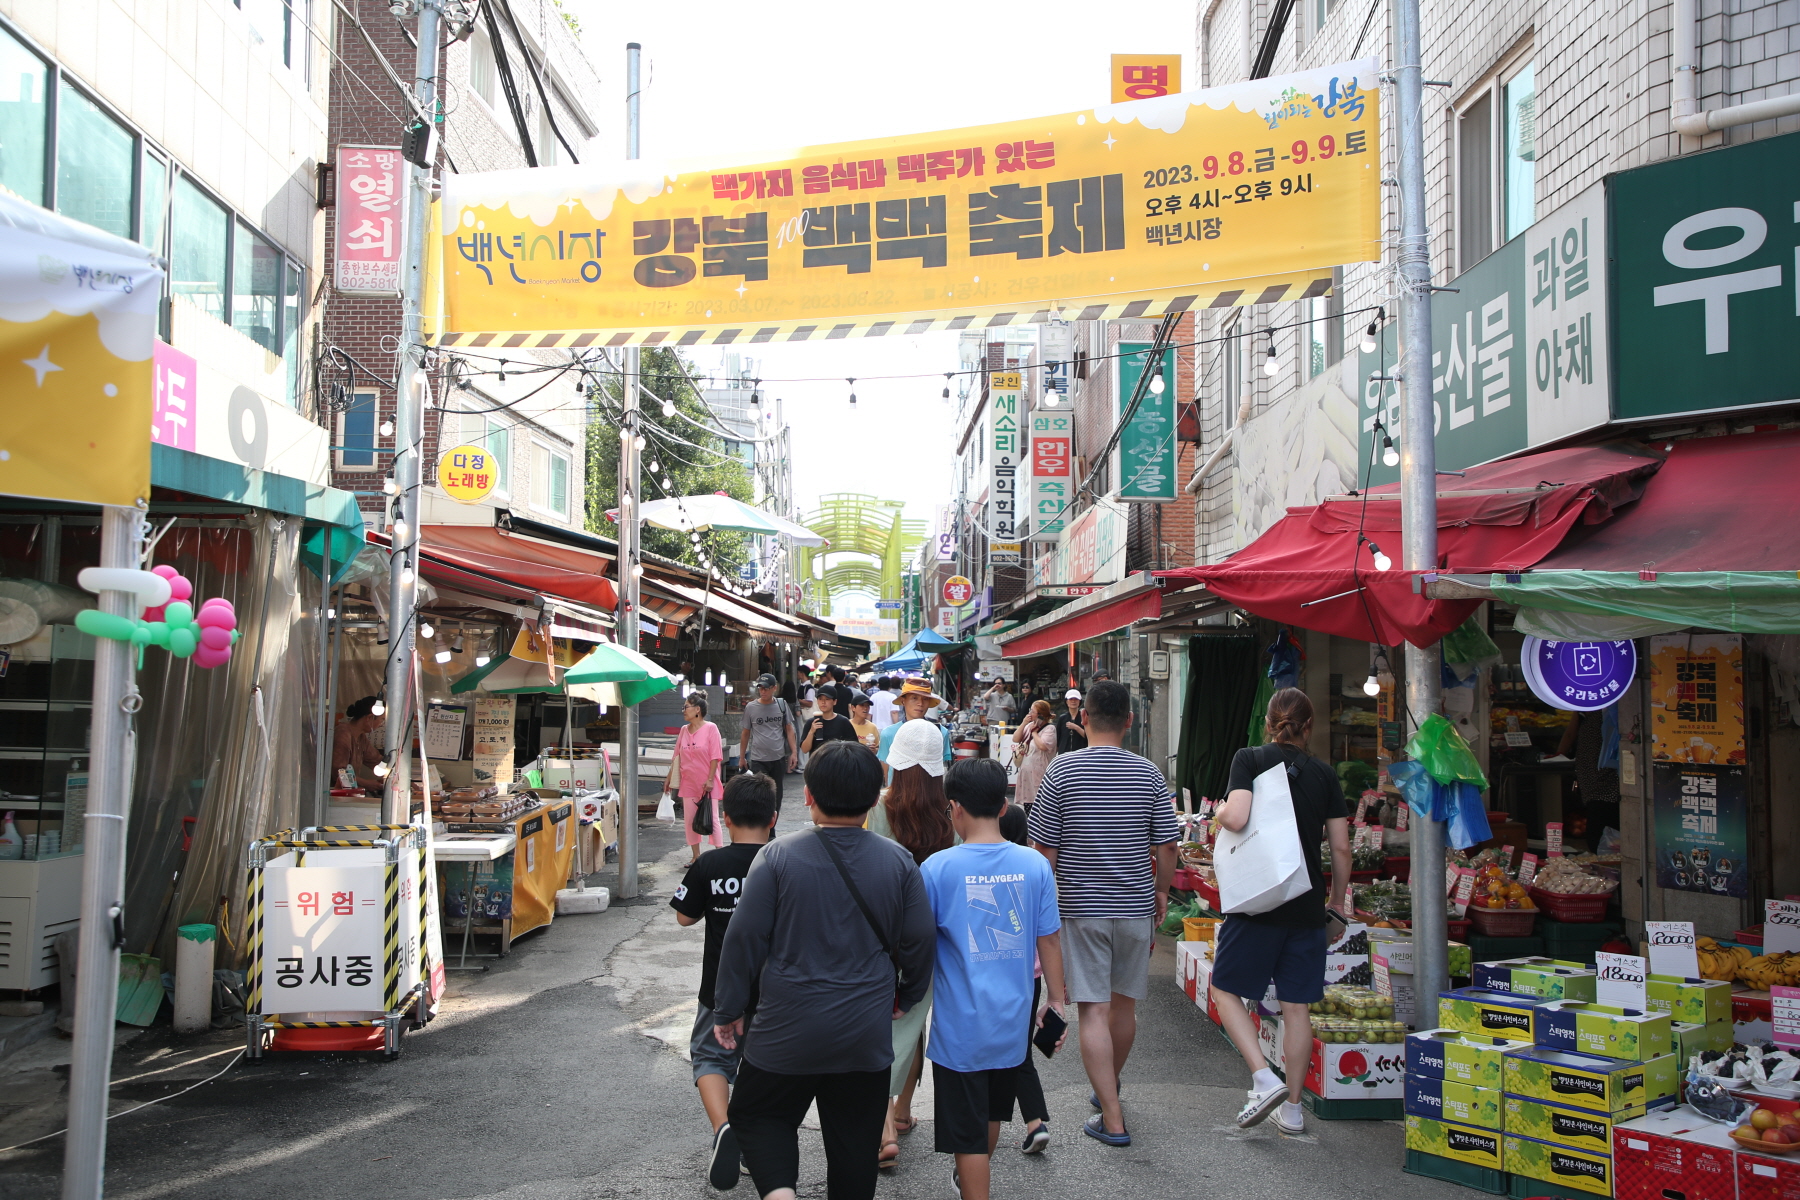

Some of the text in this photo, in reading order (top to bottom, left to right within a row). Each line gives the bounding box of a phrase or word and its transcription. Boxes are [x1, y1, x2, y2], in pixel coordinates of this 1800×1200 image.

[1122, 65, 1168, 100] 명
[1311, 76, 1365, 122] 강북
[346, 151, 398, 171] 소망
[711, 139, 1056, 202] 백가지 음식과 맥주가 있는
[1145, 193, 1182, 218] 오후
[1280, 173, 1313, 197] 9시
[346, 172, 394, 258] 열쇠
[632, 211, 769, 288] 강북
[802, 194, 948, 275] 백맥
[968, 173, 1126, 260] 축제
[1145, 216, 1223, 247] 백년시장
[457, 228, 607, 286] 백년시장
[1532, 217, 1589, 312] 과일
[341, 261, 398, 277] 종합보수센터
[341, 276, 397, 290] 902-5810
[561, 277, 581, 285] Market
[1534, 311, 1593, 400] 야채
[993, 376, 1018, 388] 관인
[994, 394, 1017, 454] 새소리
[1033, 417, 1069, 431] 삼호
[453, 454, 485, 470] 다정
[1037, 441, 1068, 473] 한우
[447, 472, 490, 489] 노래방
[994, 456, 1017, 540] 음악학원
[1037, 481, 1068, 534] 축산물
[947, 583, 967, 601] 쌀
[1676, 662, 1717, 682] 강북
[1563, 678, 1620, 701] 우리농산물
[764, 715, 783, 724] Jeep
[1677, 702, 1718, 722] 축제
[1681, 775, 1717, 796] 강북
[1681, 795, 1717, 815] 백맥
[1681, 813, 1718, 834] 축제
[964, 873, 1025, 884] EZ PLAYGEAR
[1007, 908, 1021, 933] NEPA
[1654, 931, 1695, 945] 20000
[1389, 952, 1413, 962] 샤인머
[275, 955, 374, 989] 공사중
[1604, 965, 1645, 983] 18000
[1486, 976, 1510, 992] 스타영천
[1513, 980, 1537, 995] 스타포도
[1548, 1023, 1575, 1041] 스타영천
[1578, 1027, 1606, 1045] 스타포도
[1418, 1052, 1444, 1069] 스타영천
[1446, 1057, 1471, 1075] 스타포도
[1417, 1090, 1442, 1107] 스타영천
[1443, 1096, 1469, 1113] 스타포도
[1237, 1106, 1258, 1124] crocs
